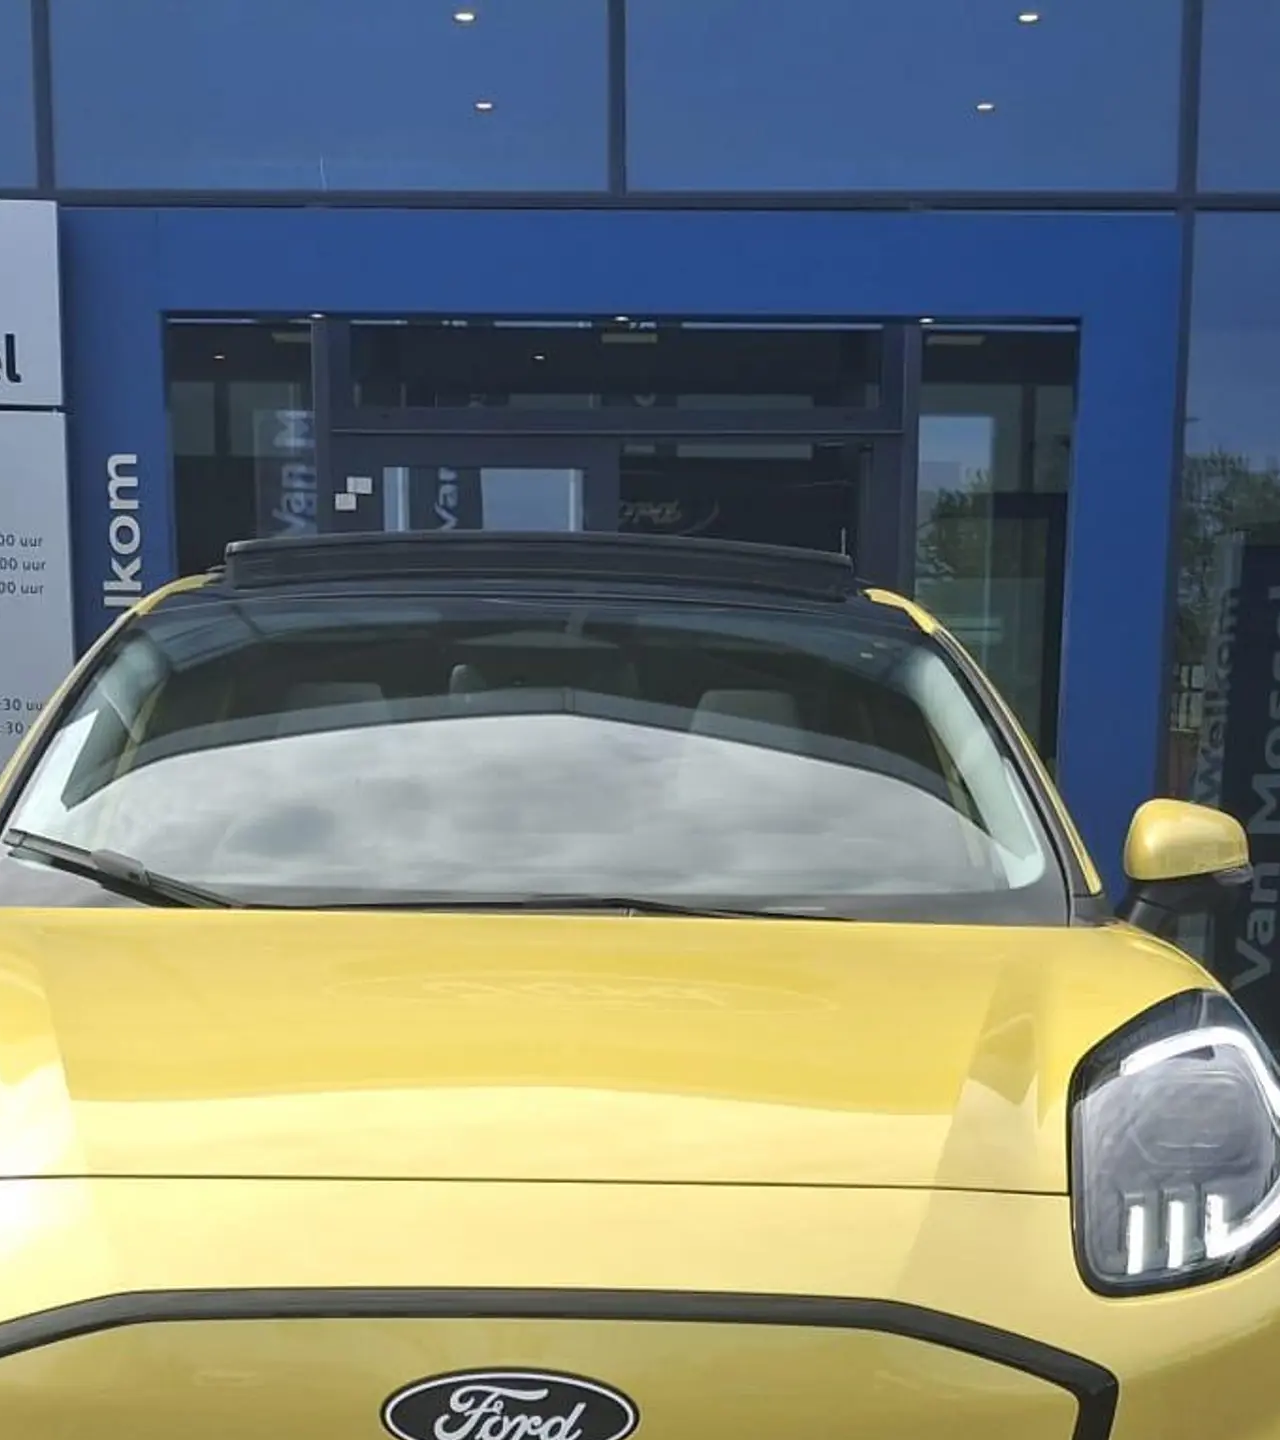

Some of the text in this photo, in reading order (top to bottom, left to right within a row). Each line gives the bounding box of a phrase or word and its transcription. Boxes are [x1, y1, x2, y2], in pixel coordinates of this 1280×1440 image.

[20, 536, 43, 548] uur
[22, 560, 46, 571] uur
[21, 584, 44, 595] uur
[1231, 862, 1280, 990] Van
